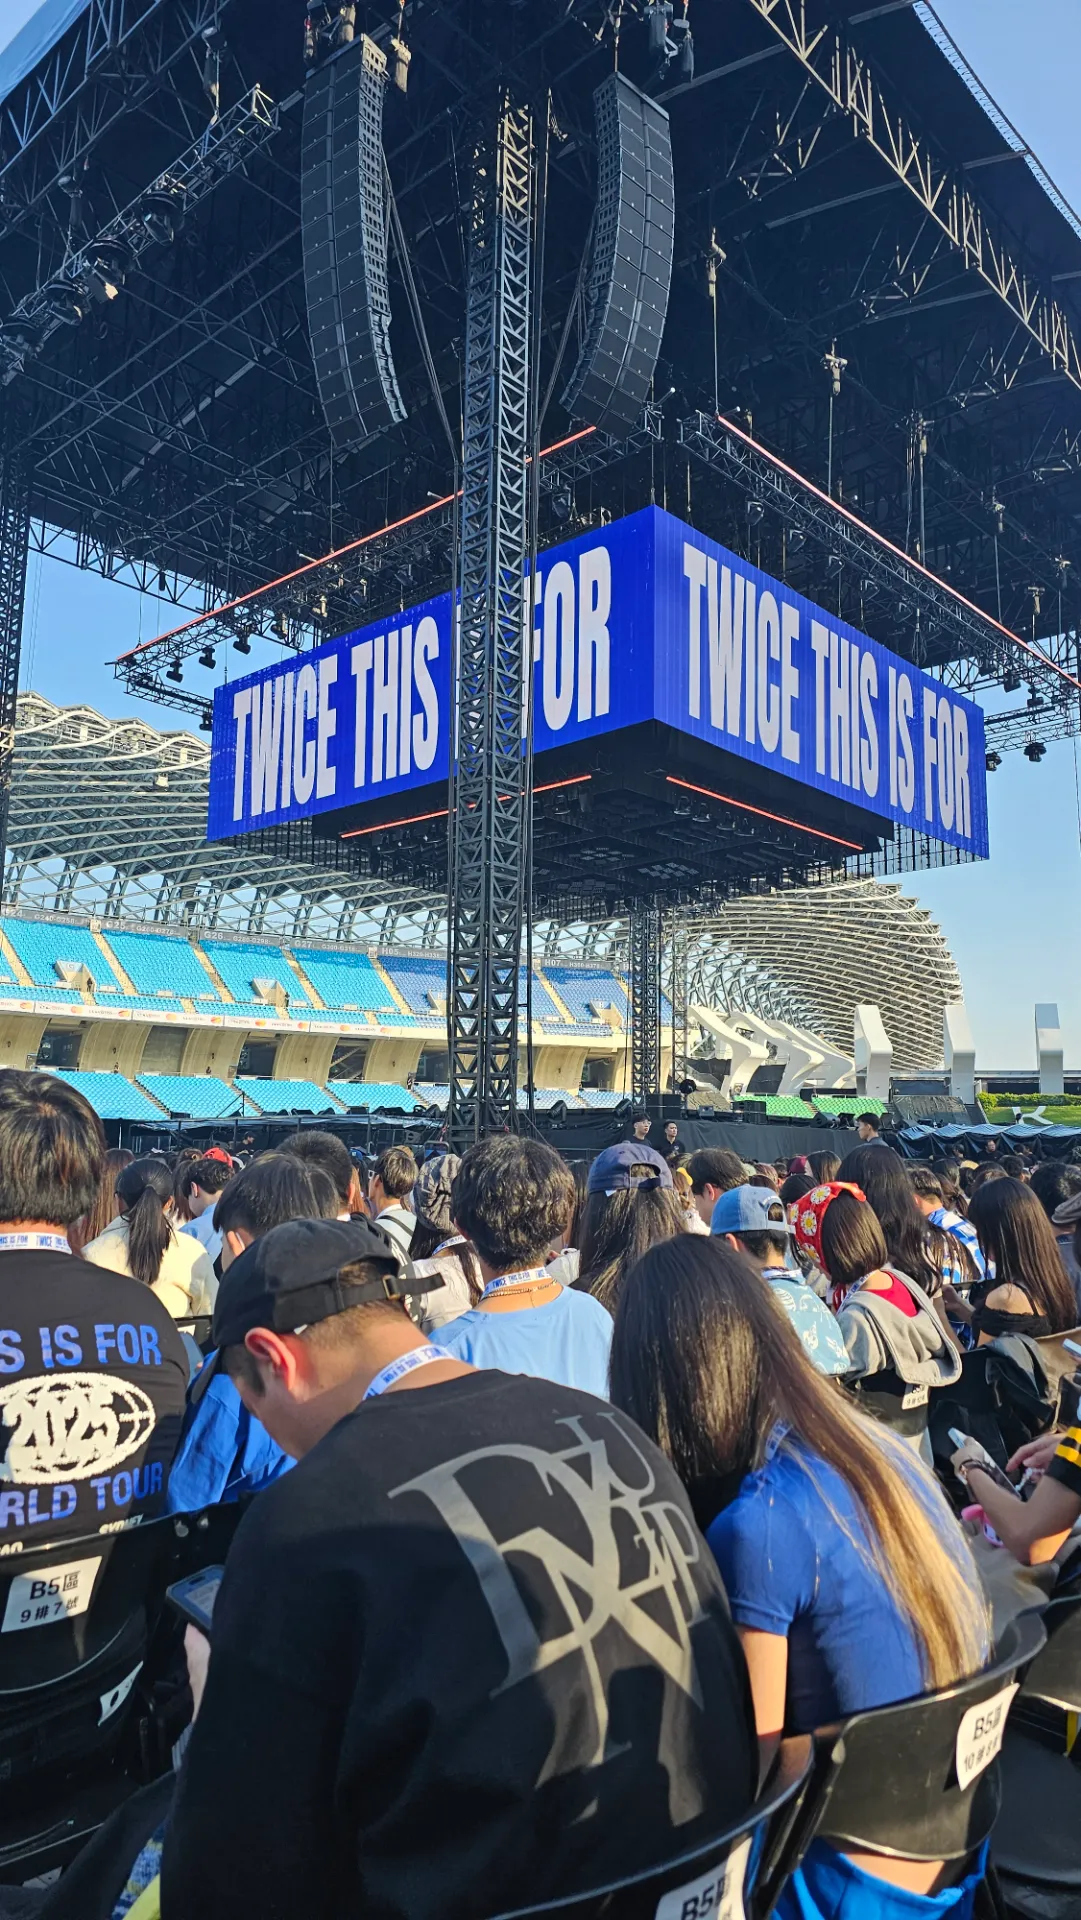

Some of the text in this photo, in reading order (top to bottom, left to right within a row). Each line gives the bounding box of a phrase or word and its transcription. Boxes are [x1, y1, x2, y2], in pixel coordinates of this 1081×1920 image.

[233, 654, 337, 821] TWICE
[350, 616, 439, 789] THIS
[521, 545, 612, 739] FOR
[683, 541, 971, 839] TWICE THIS IS FOR
[106, 920, 126, 929] G25
[203, 930, 224, 940] G26
[294, 940, 312, 949] G27
[381, 947, 399, 955] H05
[544, 959, 561, 967] H07
[36, 1235, 52, 1247] TWICE
[0, 1324, 162, 1373] S IS FOR
[0, 1462, 163, 1528] RLD TOUR
[30, 1570, 81, 1600] B5區
